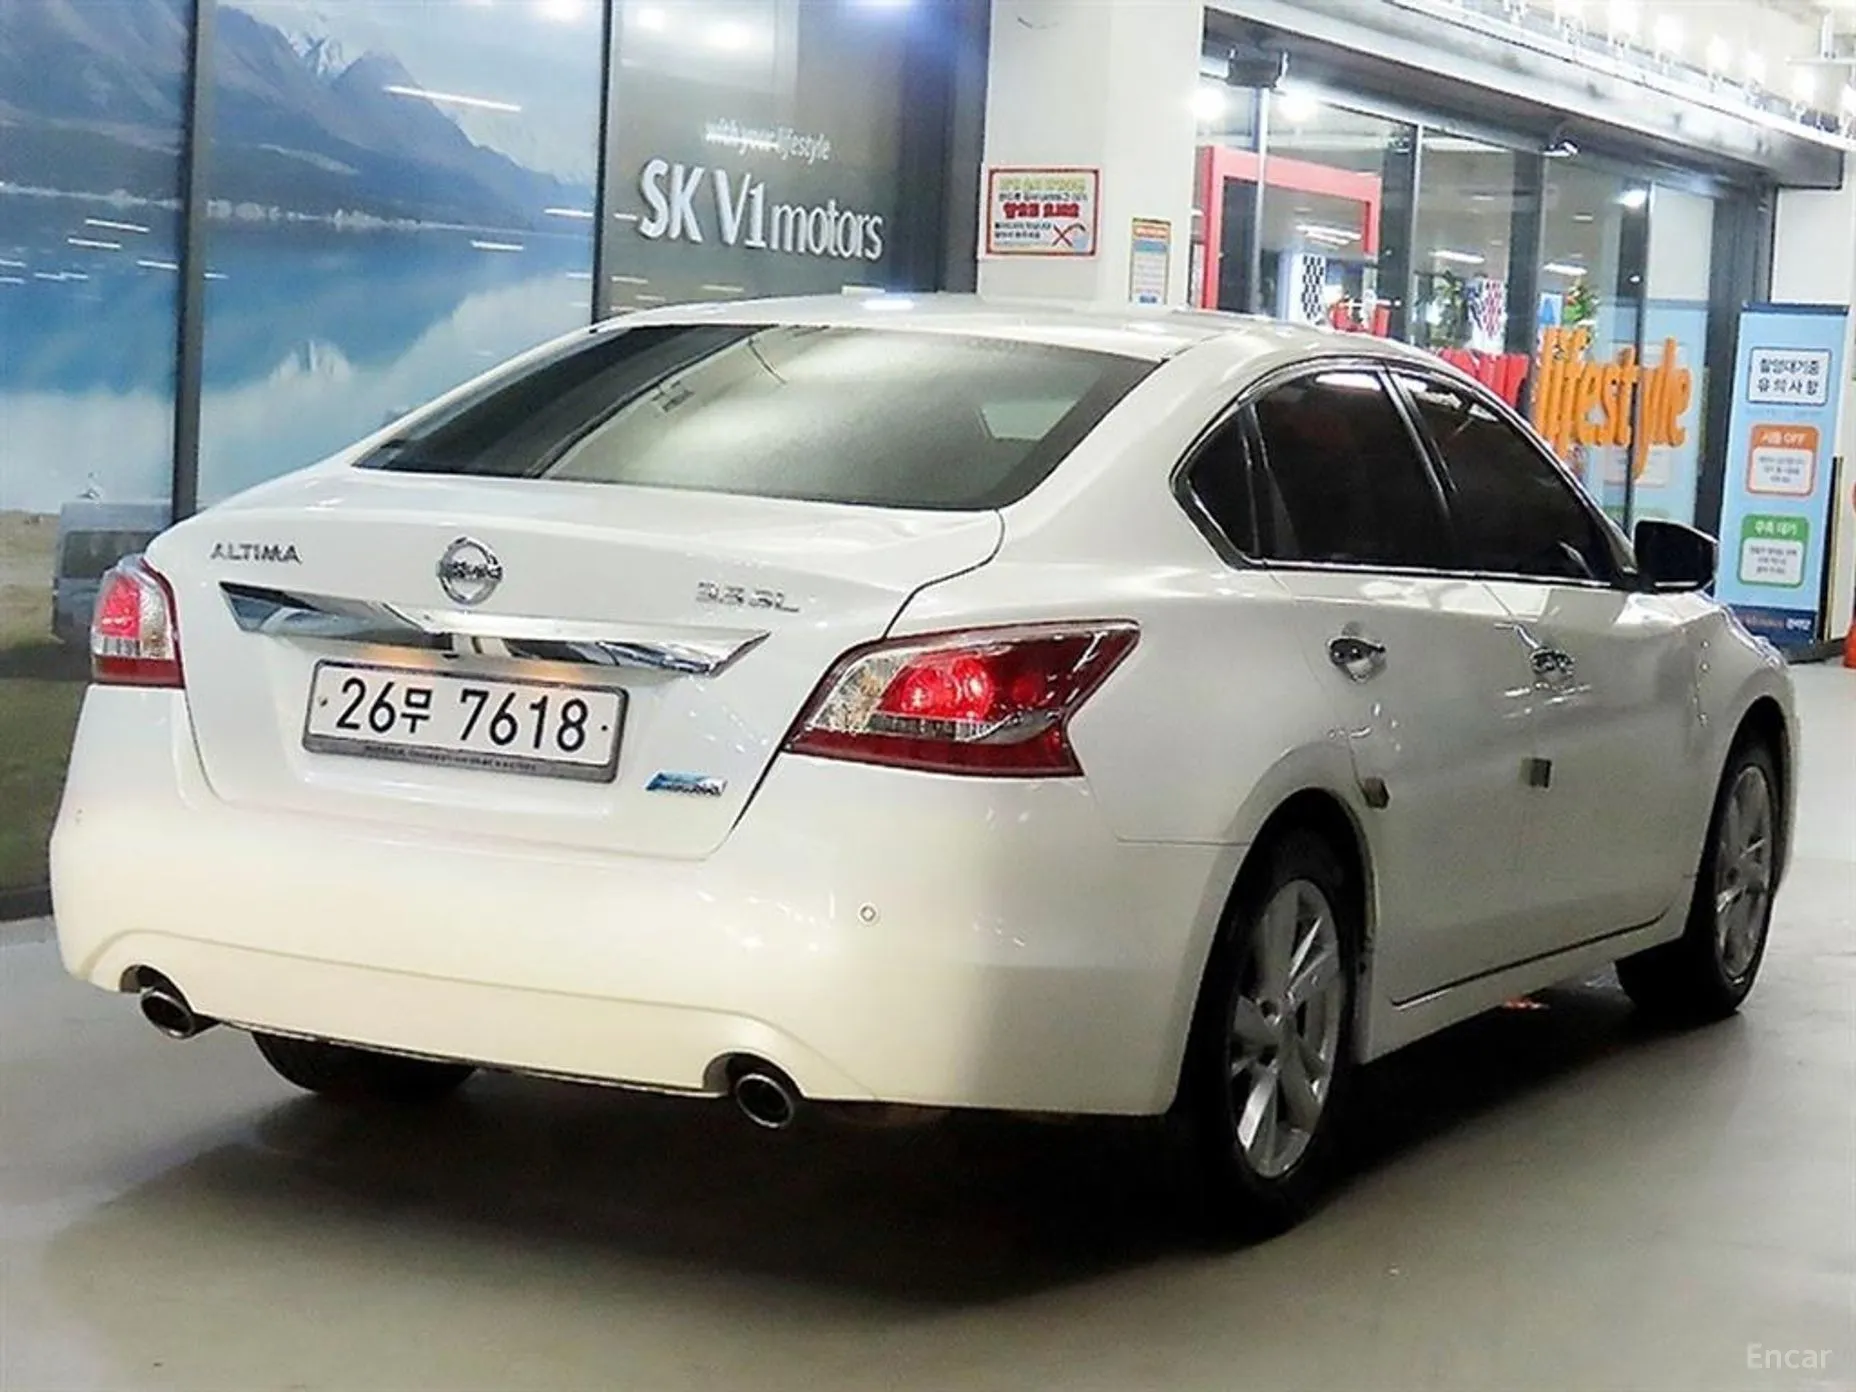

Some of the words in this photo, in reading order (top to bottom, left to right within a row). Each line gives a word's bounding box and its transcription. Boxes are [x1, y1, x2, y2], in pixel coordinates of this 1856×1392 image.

[638, 158, 705, 242] SK
[1534, 326, 1693, 480] lifestyle
[210, 542, 303, 566] ALTIMA
[336, 677, 433, 734] 26무
[459, 688, 589, 752] 7618
